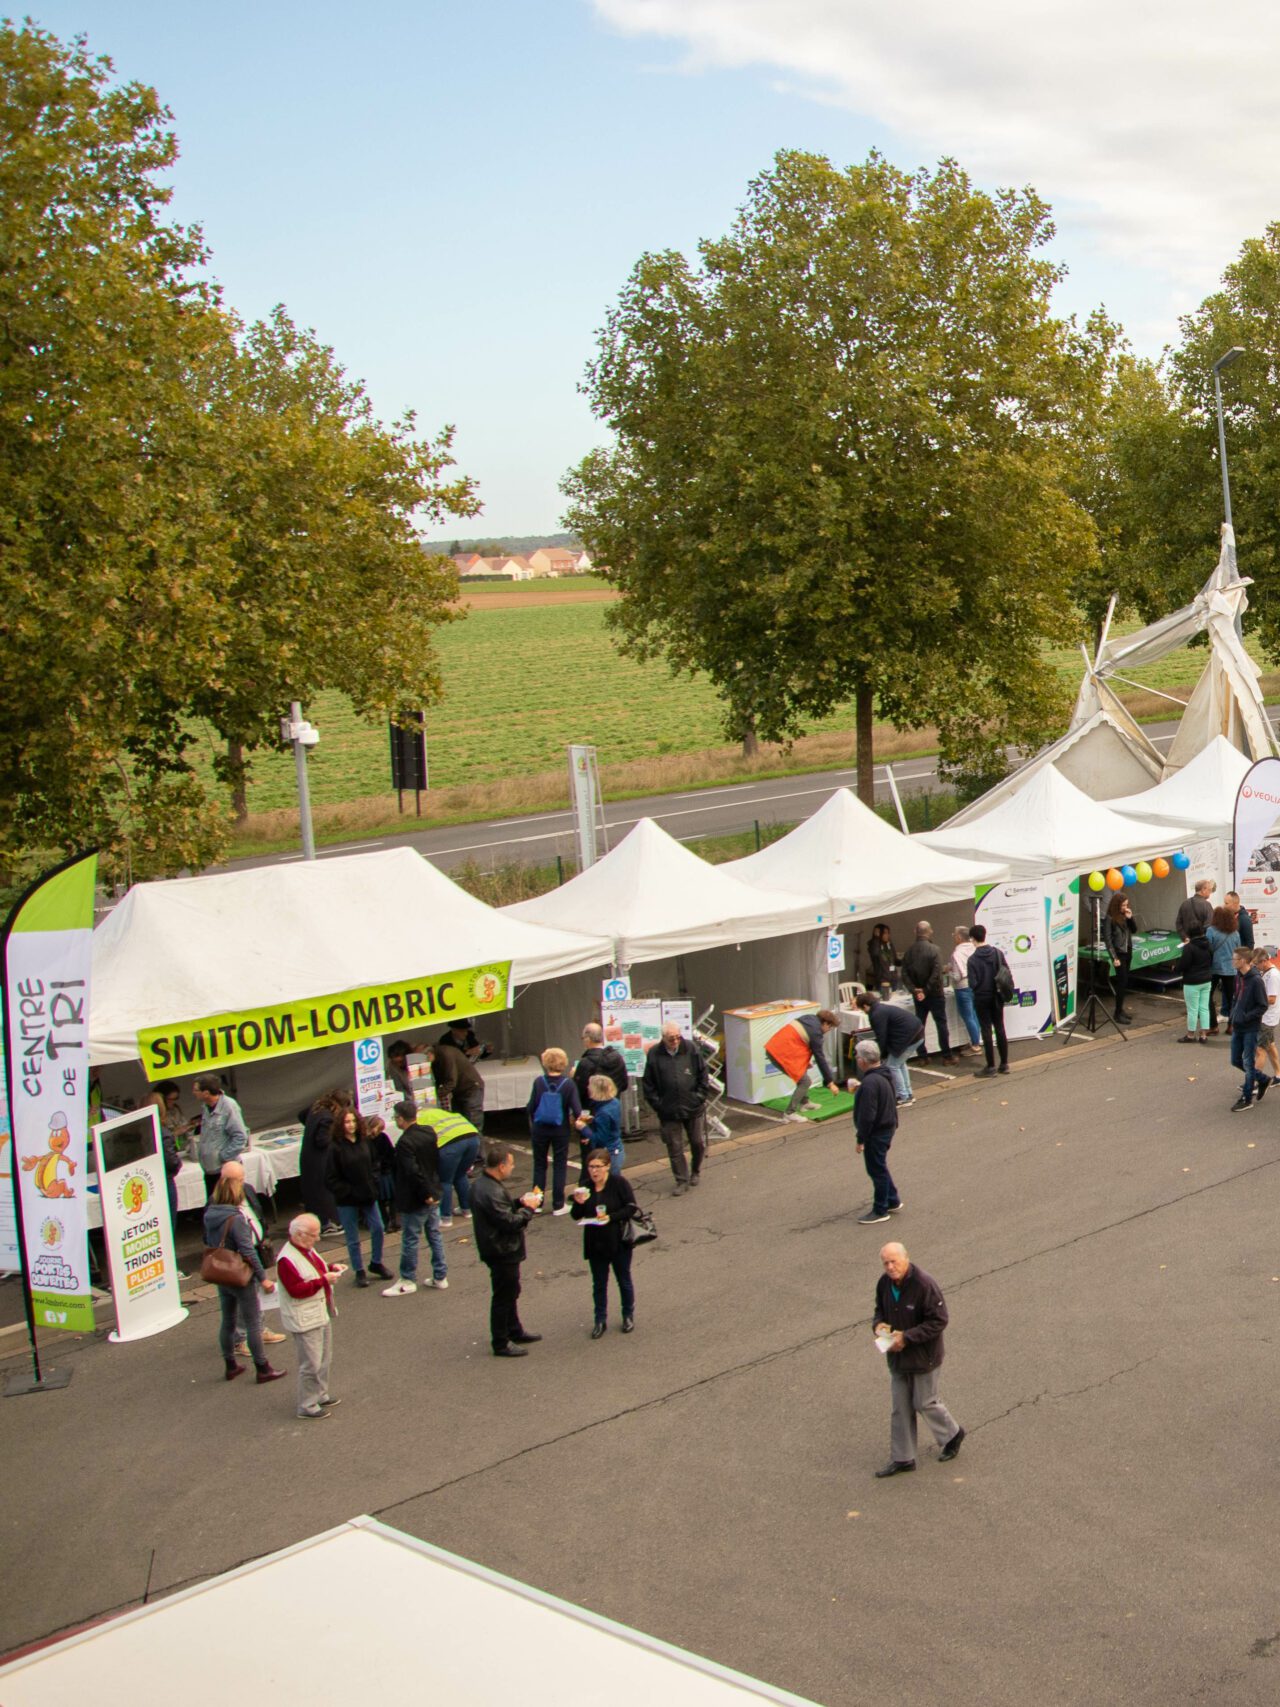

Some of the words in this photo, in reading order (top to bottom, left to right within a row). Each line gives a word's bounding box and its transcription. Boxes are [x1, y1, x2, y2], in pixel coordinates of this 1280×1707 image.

[1150, 946, 1171, 957] VEOLIA
[608, 983, 627, 1000] 16
[46, 980, 85, 1060] TRI
[151, 982, 457, 1070] SMITOM-LOMBRIC
[18, 978, 45, 1097] CENTRE
[361, 1043, 379, 1061] 16
[63, 1067, 76, 1096] DE
[121, 1217, 159, 1241] JETONS
[126, 1232, 158, 1254] MOINS
[124, 1246, 163, 1271] TRIONS
[34, 1262, 73, 1278] PORTES
[130, 1266, 155, 1286] PLUS
[31, 1273, 79, 1290] OUVERTES
